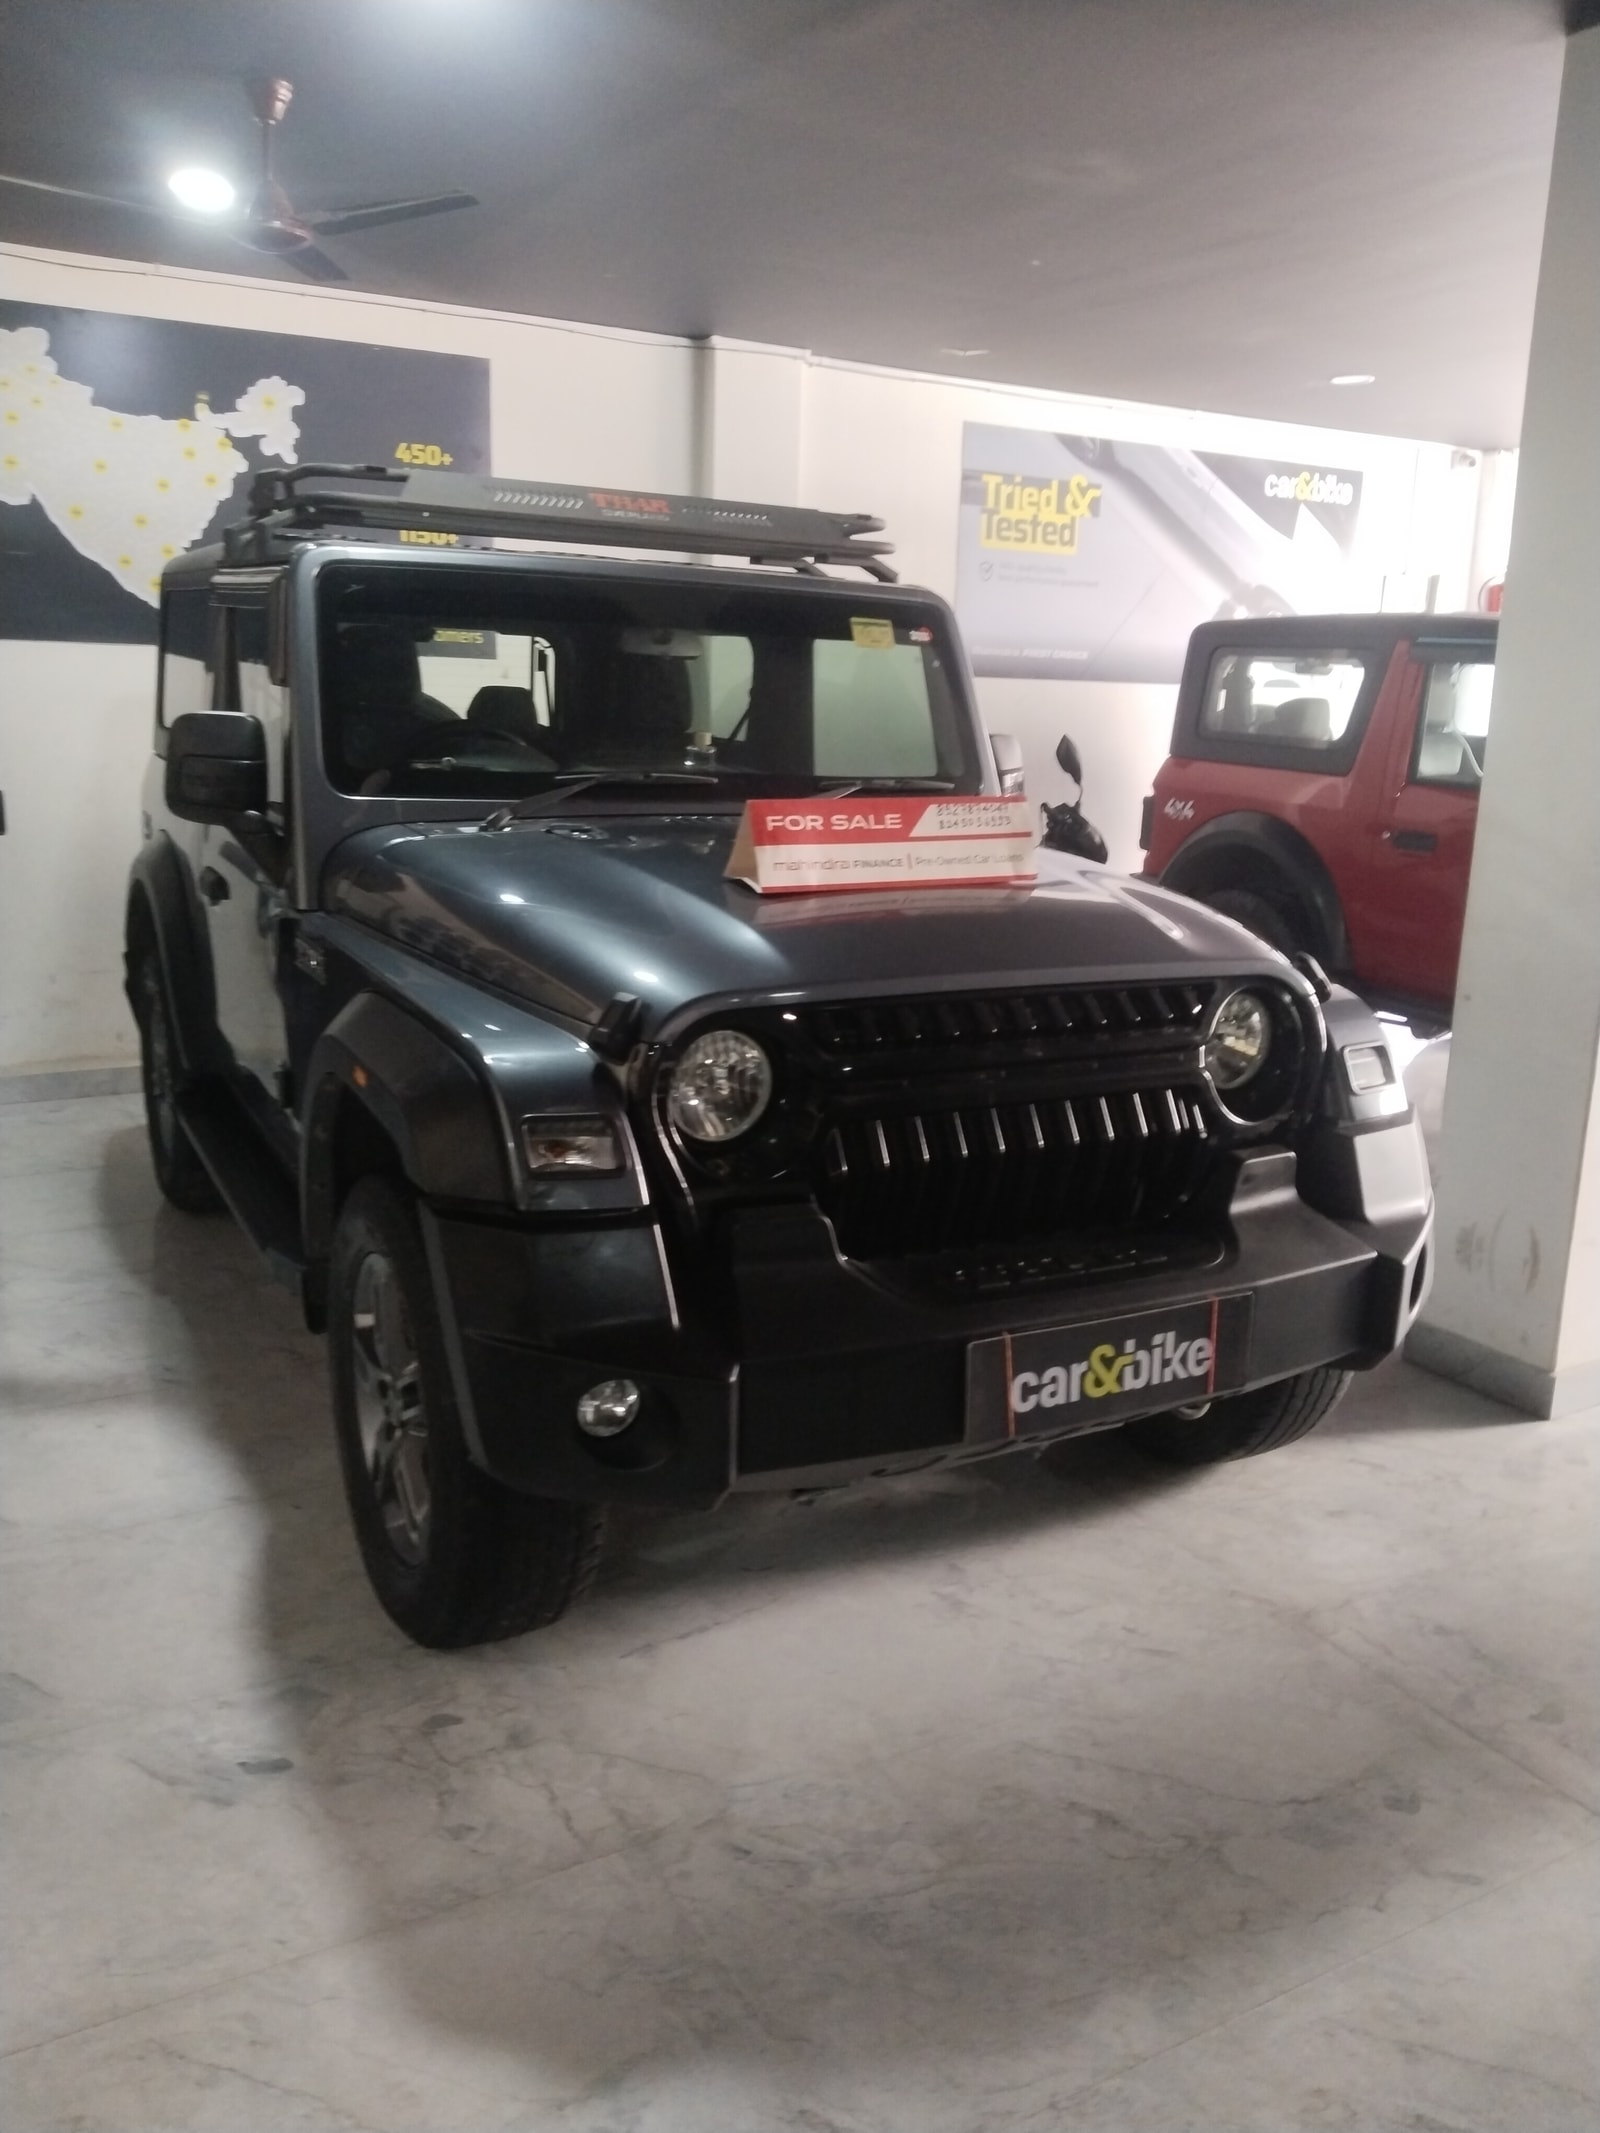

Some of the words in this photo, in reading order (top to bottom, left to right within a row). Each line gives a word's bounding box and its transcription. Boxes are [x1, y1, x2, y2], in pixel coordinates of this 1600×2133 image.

[395, 442, 454, 467] 450+
[982, 473, 1059, 513] Tried
[1065, 474, 1102, 517] &
[1264, 471, 1354, 506] car&bike
[981, 509, 1076, 548] Tested
[766, 815, 824, 831] FOR
[830, 813, 903, 830] SALE
[853, 858, 904, 869] FINANCE
[1010, 1331, 1214, 1413] car&bike
